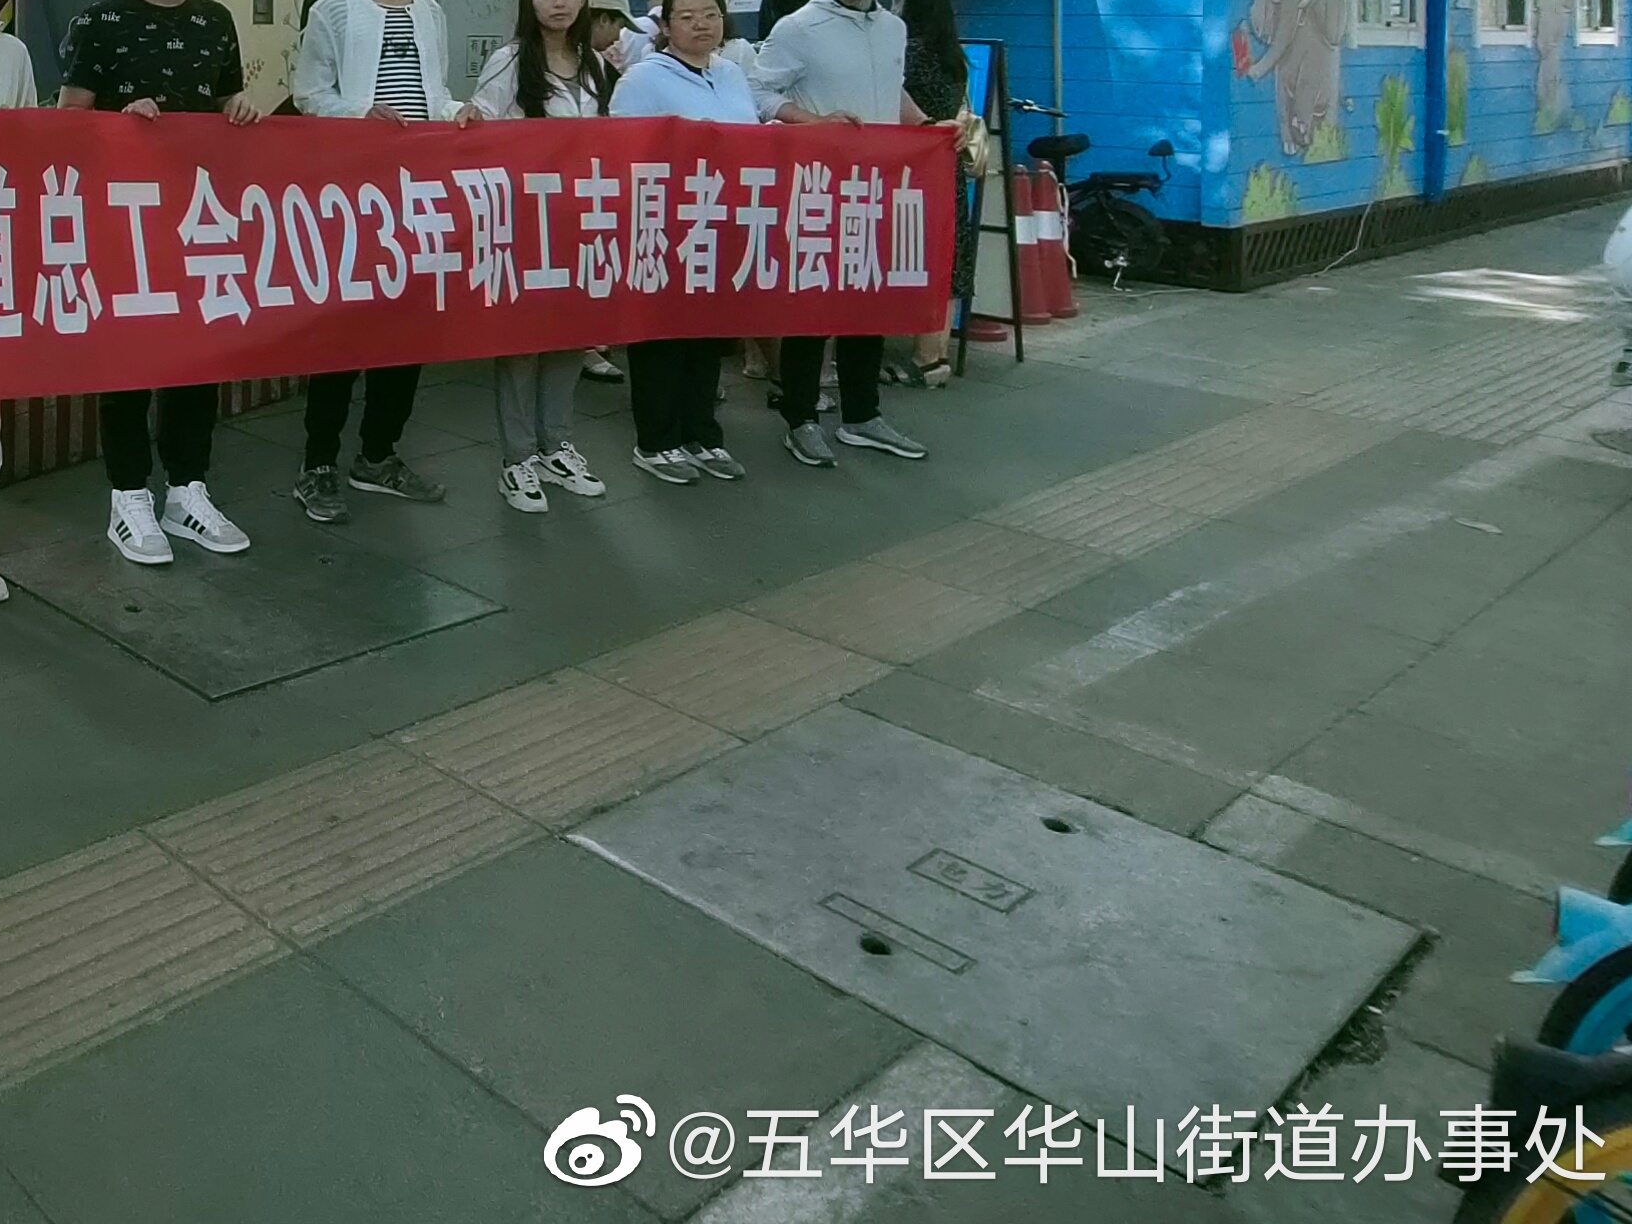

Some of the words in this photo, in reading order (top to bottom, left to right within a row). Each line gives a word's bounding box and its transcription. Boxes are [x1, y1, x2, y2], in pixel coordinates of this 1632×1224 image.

[101, 11, 121, 23] nike
[190, 14, 208, 26] nike
[166, 38, 185, 51] nike
[118, 81, 136, 94] nike
